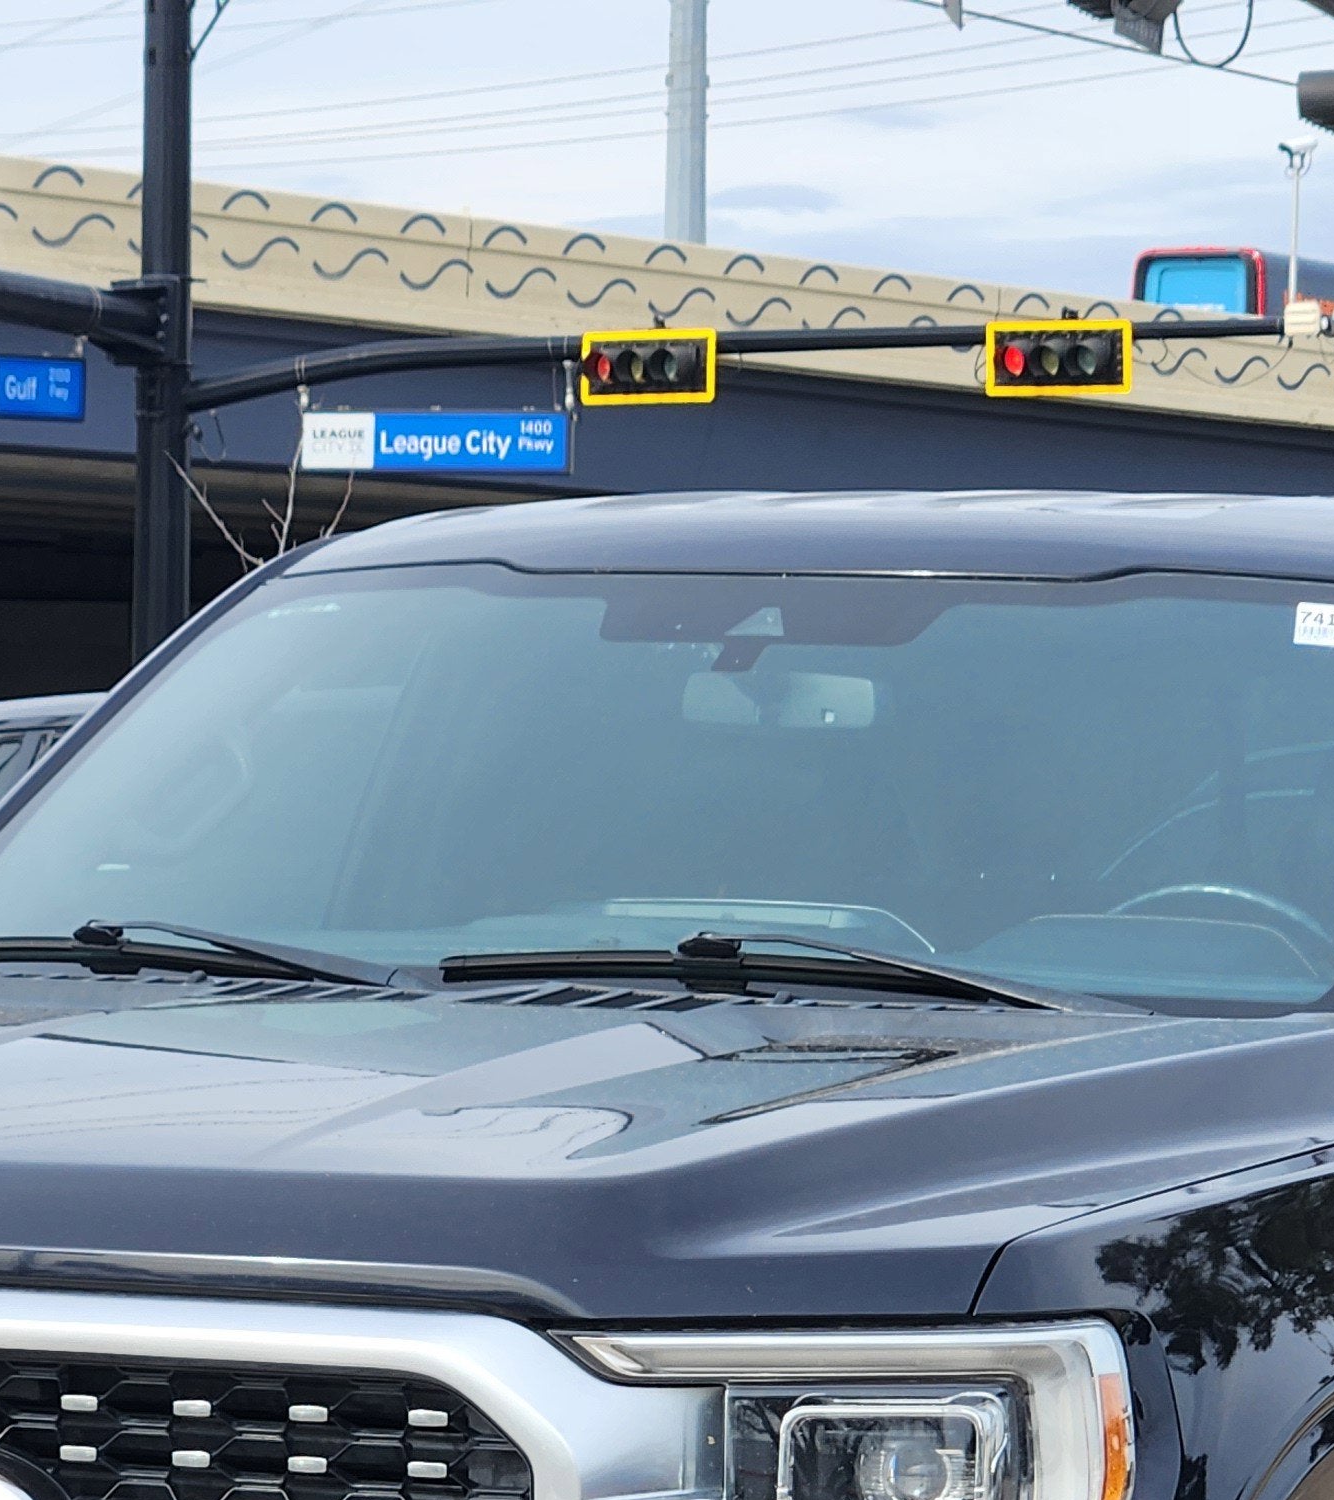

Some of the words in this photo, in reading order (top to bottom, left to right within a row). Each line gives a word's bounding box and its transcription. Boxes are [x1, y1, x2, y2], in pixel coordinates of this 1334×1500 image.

[4, 374, 38, 401] Gulf
[312, 429, 365, 440] LEAGUE
[519, 420, 553, 434] 1400
[379, 430, 462, 461] League
[465, 429, 512, 460] City
[517, 436, 555, 454] Pkwy
